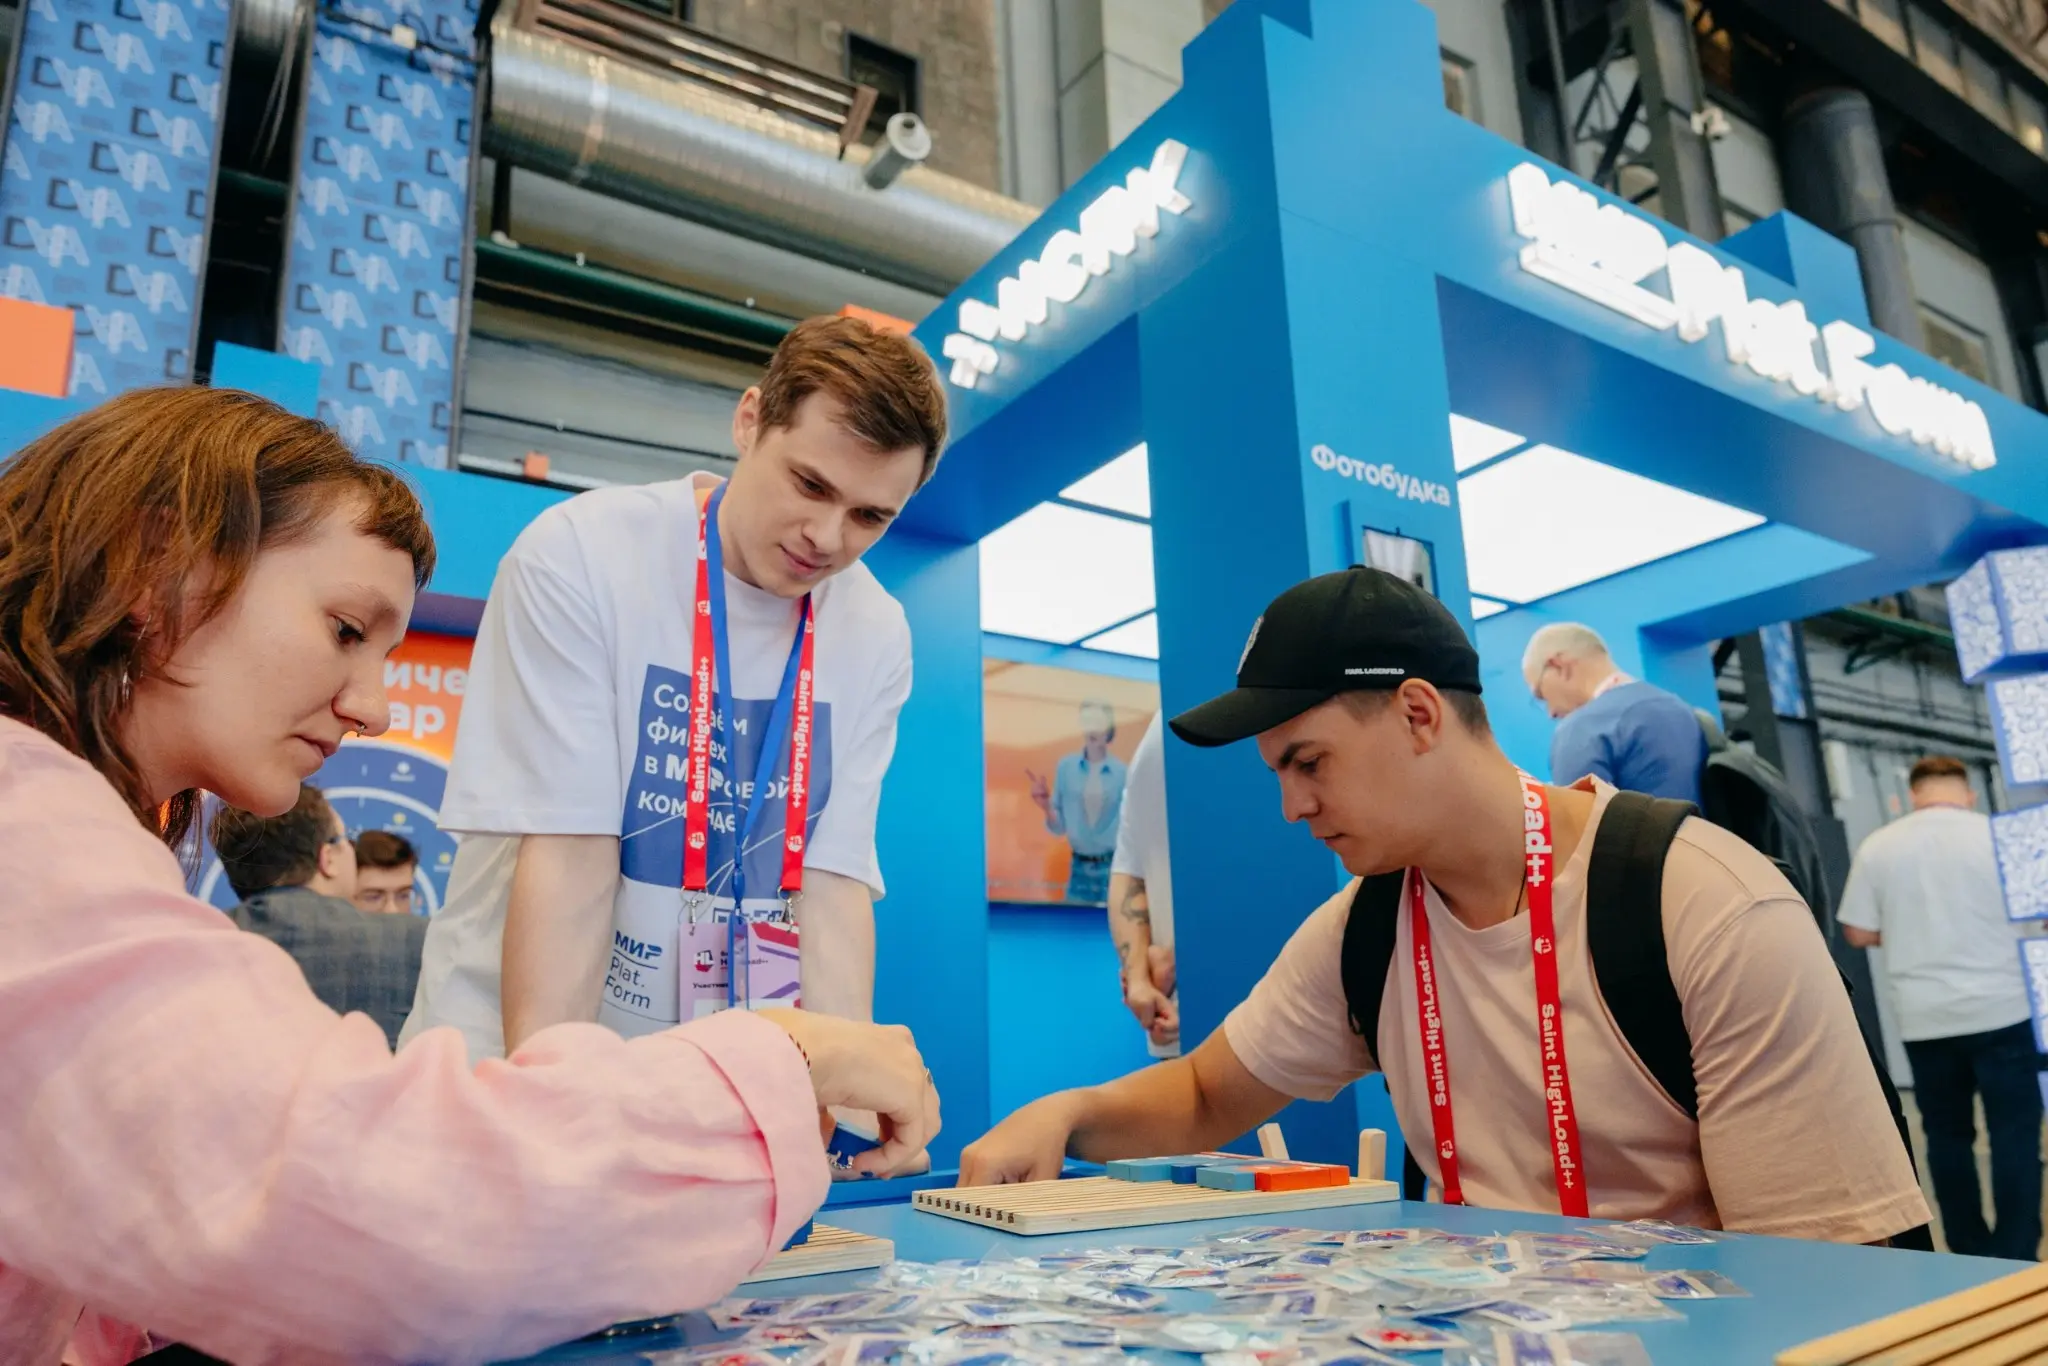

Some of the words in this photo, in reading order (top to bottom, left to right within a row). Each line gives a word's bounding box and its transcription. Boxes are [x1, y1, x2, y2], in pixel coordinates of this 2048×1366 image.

[1311, 444, 1450, 507] Фотобудка
[384, 660, 468, 697] иче
[798, 669, 812, 712] Saint
[388, 700, 446, 740] ар
[693, 656, 711, 753] HighLoad++
[647, 716, 727, 763] фиех
[792, 713, 810, 809] HighLoad++
[644, 755, 658, 775] в
[691, 756, 706, 803] Saint
[1518, 770, 1552, 887] Load++
[614, 929, 662, 960] МИР
[605, 974, 650, 1009] Form
[610, 956, 645, 988] Plat.
[1418, 944, 1441, 1050] HighLoad++
[1542, 1003, 1557, 1060] Saint
[1431, 1053, 1446, 1107] Saint
[1546, 1064, 1576, 1189] HighLoad++
